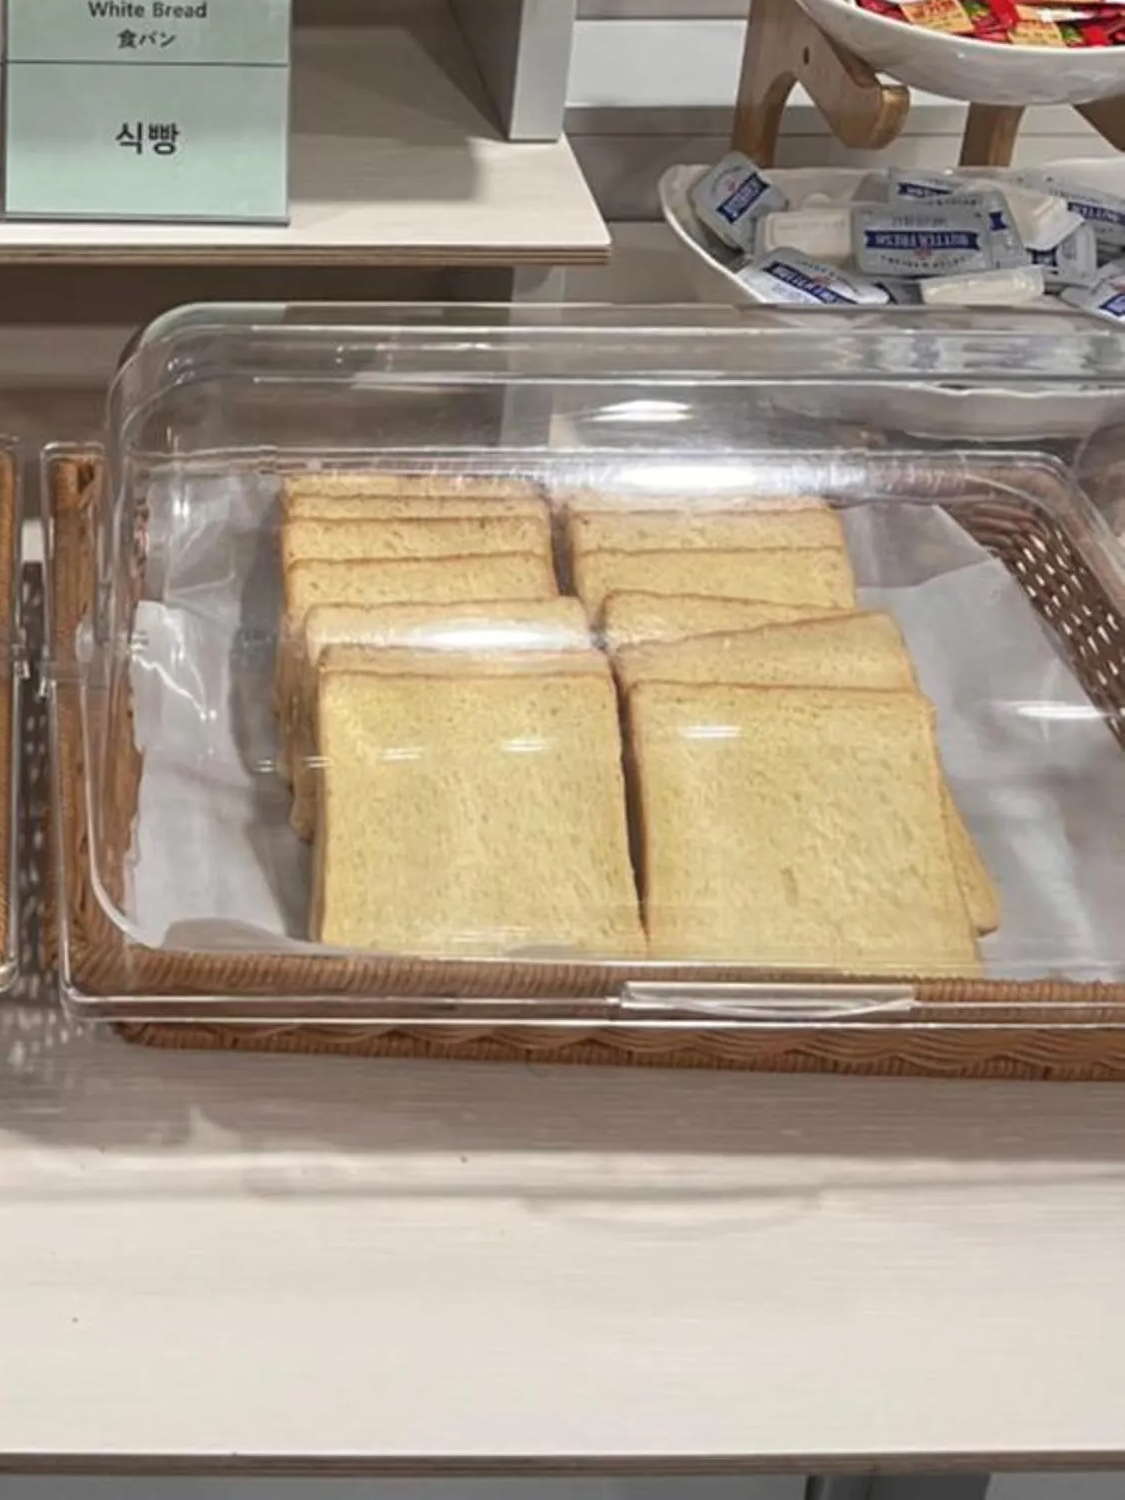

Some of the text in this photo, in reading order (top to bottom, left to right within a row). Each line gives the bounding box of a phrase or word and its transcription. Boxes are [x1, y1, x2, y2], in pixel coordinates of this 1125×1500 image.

[88, 1, 207, 18] White Bread
[115, 122, 180, 155] 식빵
